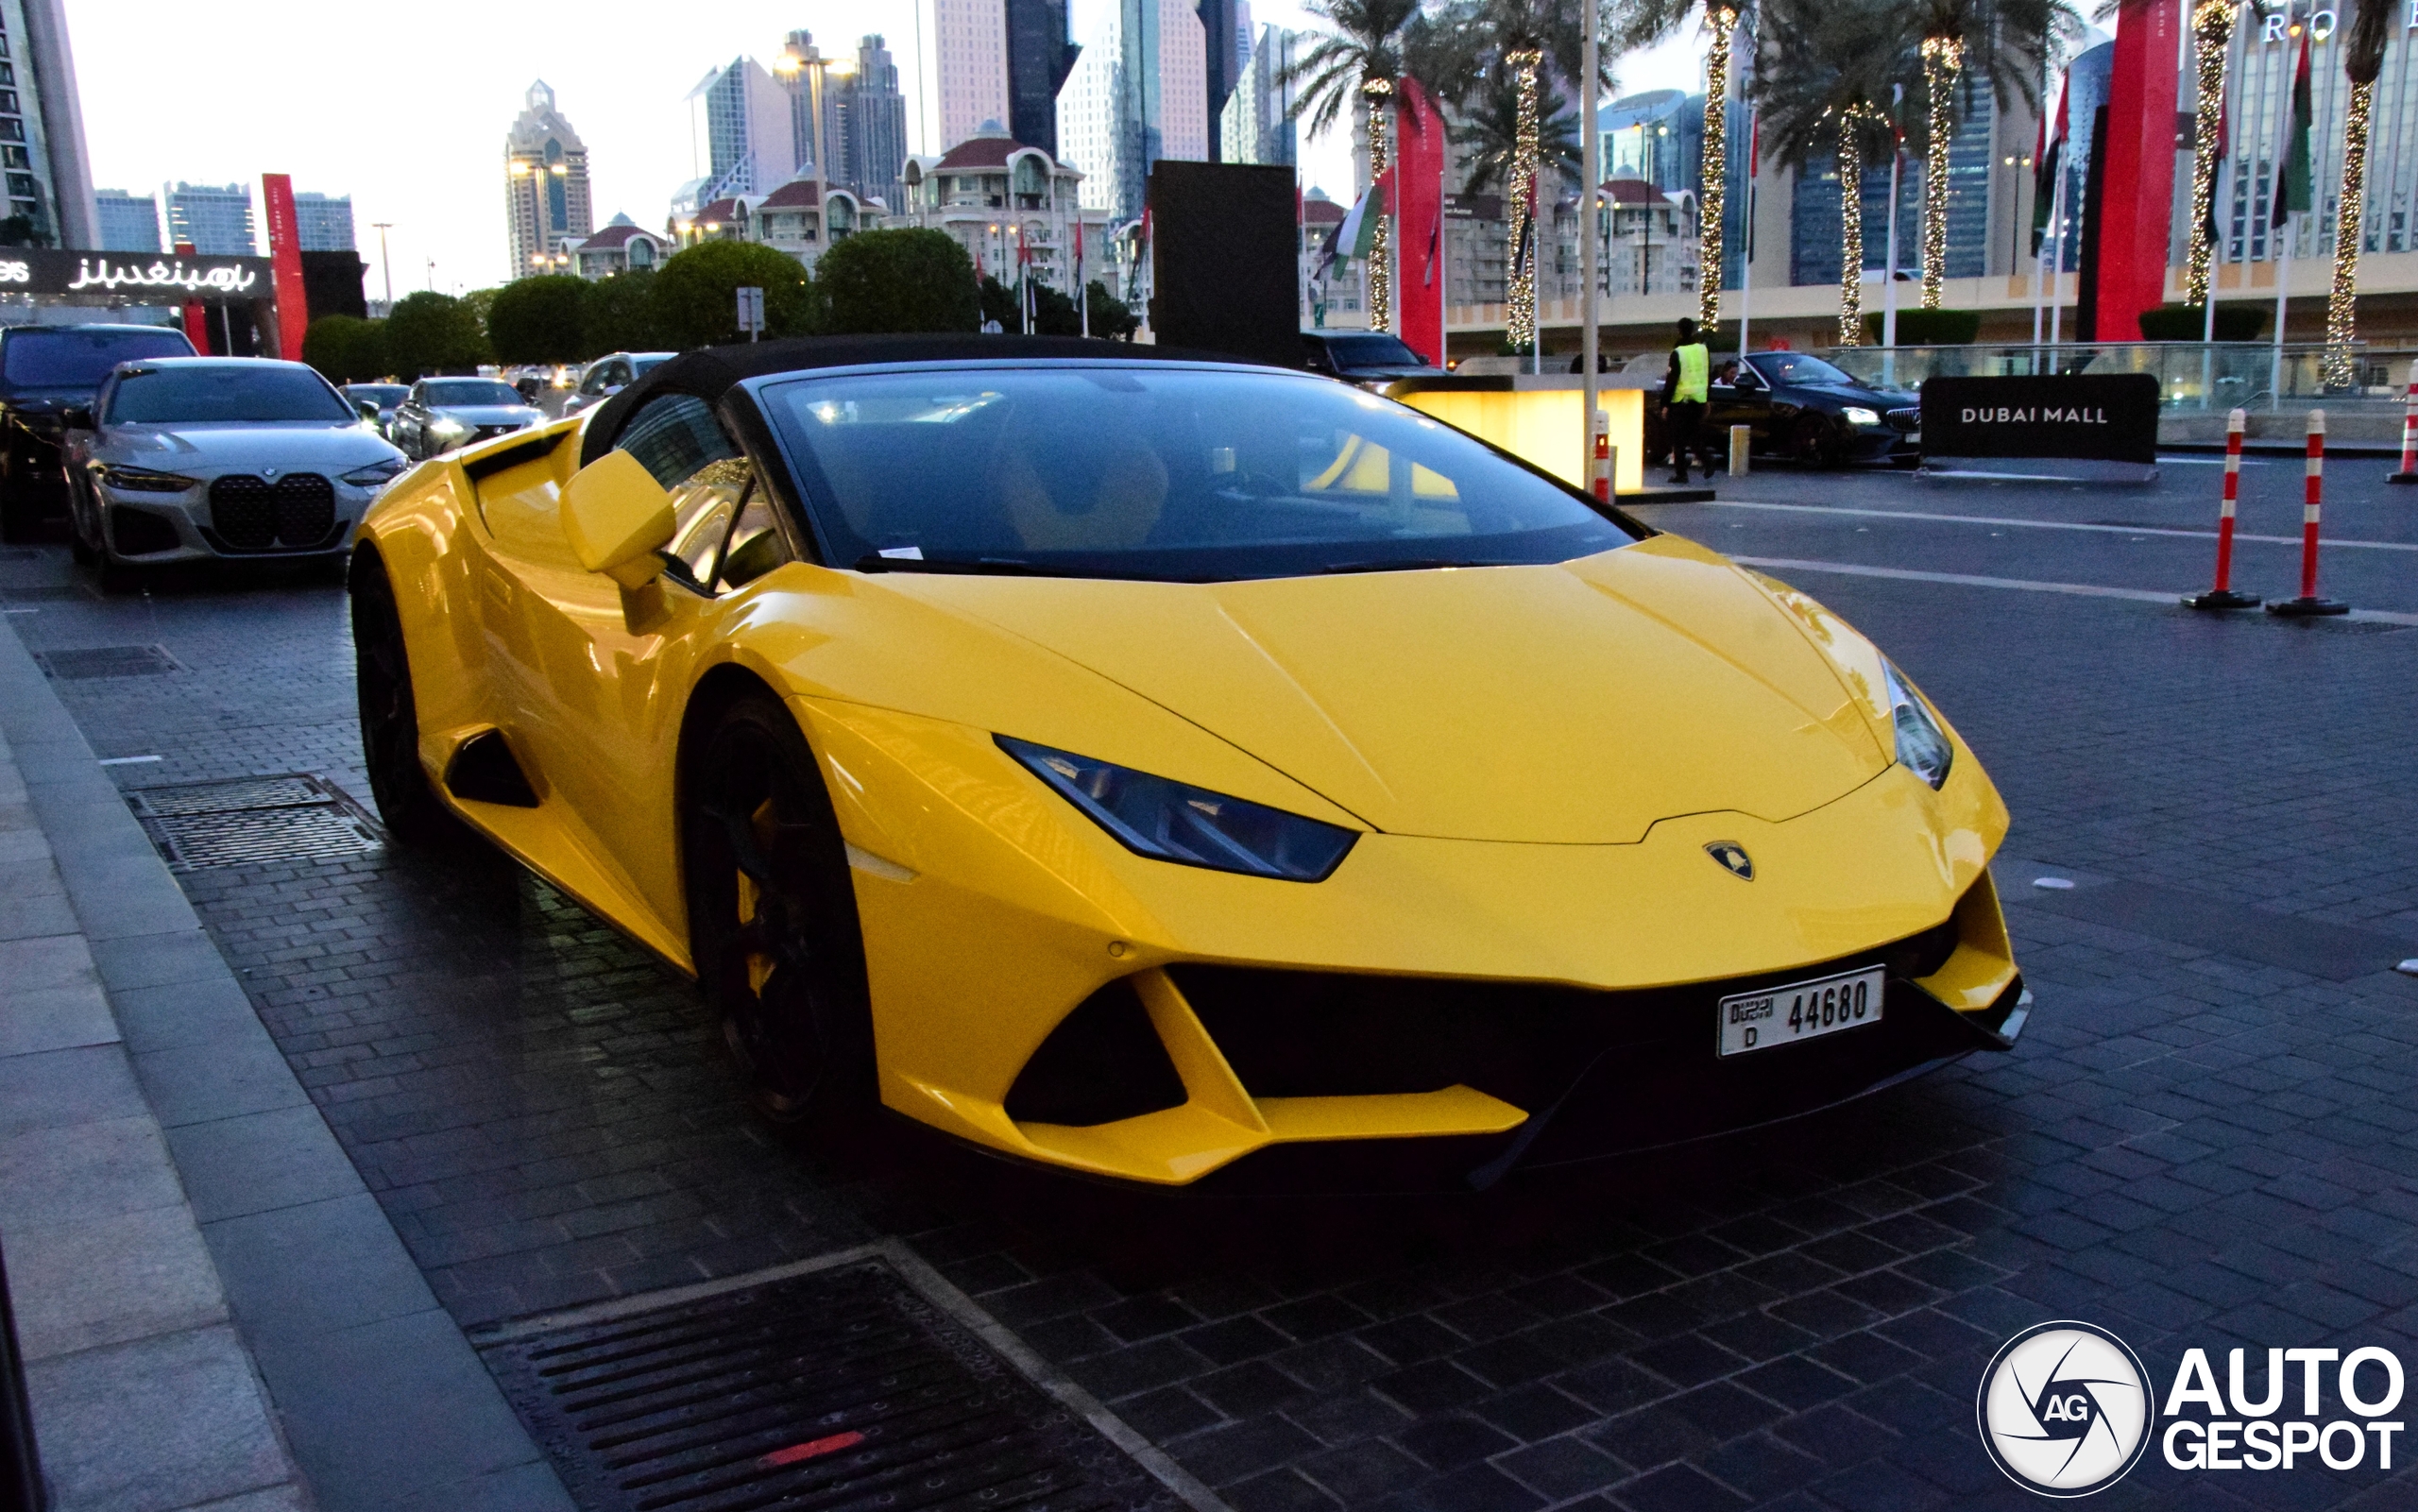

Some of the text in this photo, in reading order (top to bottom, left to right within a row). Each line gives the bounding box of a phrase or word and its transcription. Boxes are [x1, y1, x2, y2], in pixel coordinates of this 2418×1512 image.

[1962, 407, 2107, 424] DUBAI MALL
[1788, 980, 1867, 1034] 44680
[1745, 1027, 1758, 1048] D
